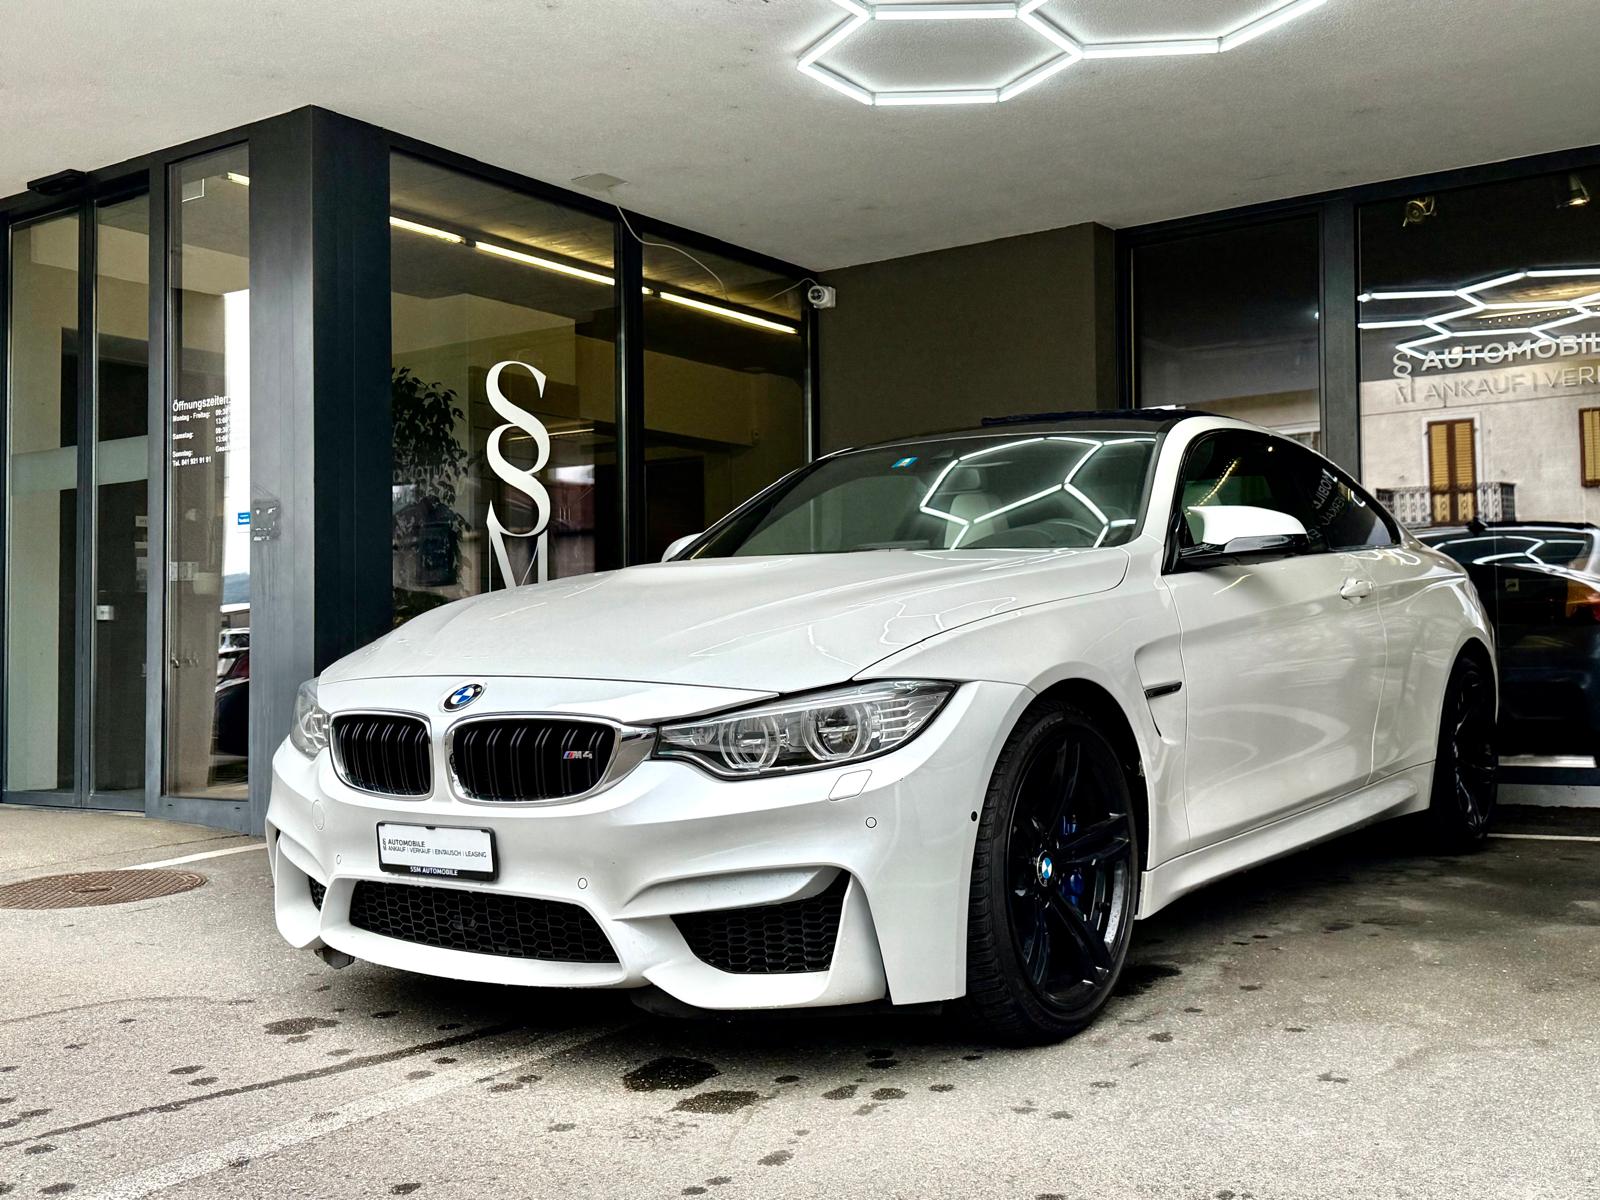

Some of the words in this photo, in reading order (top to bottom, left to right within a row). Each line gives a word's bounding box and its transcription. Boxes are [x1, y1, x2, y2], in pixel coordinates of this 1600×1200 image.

[1544, 365, 1600, 388] VER
[1424, 373, 1527, 402] ANKAUF
[388, 838, 426, 847] AUTOMOBILE
[388, 845, 406, 853] ANKAUF
[435, 849, 462, 857] EINTAUSCH
[422, 867, 459, 876] AUTOMOBILE
